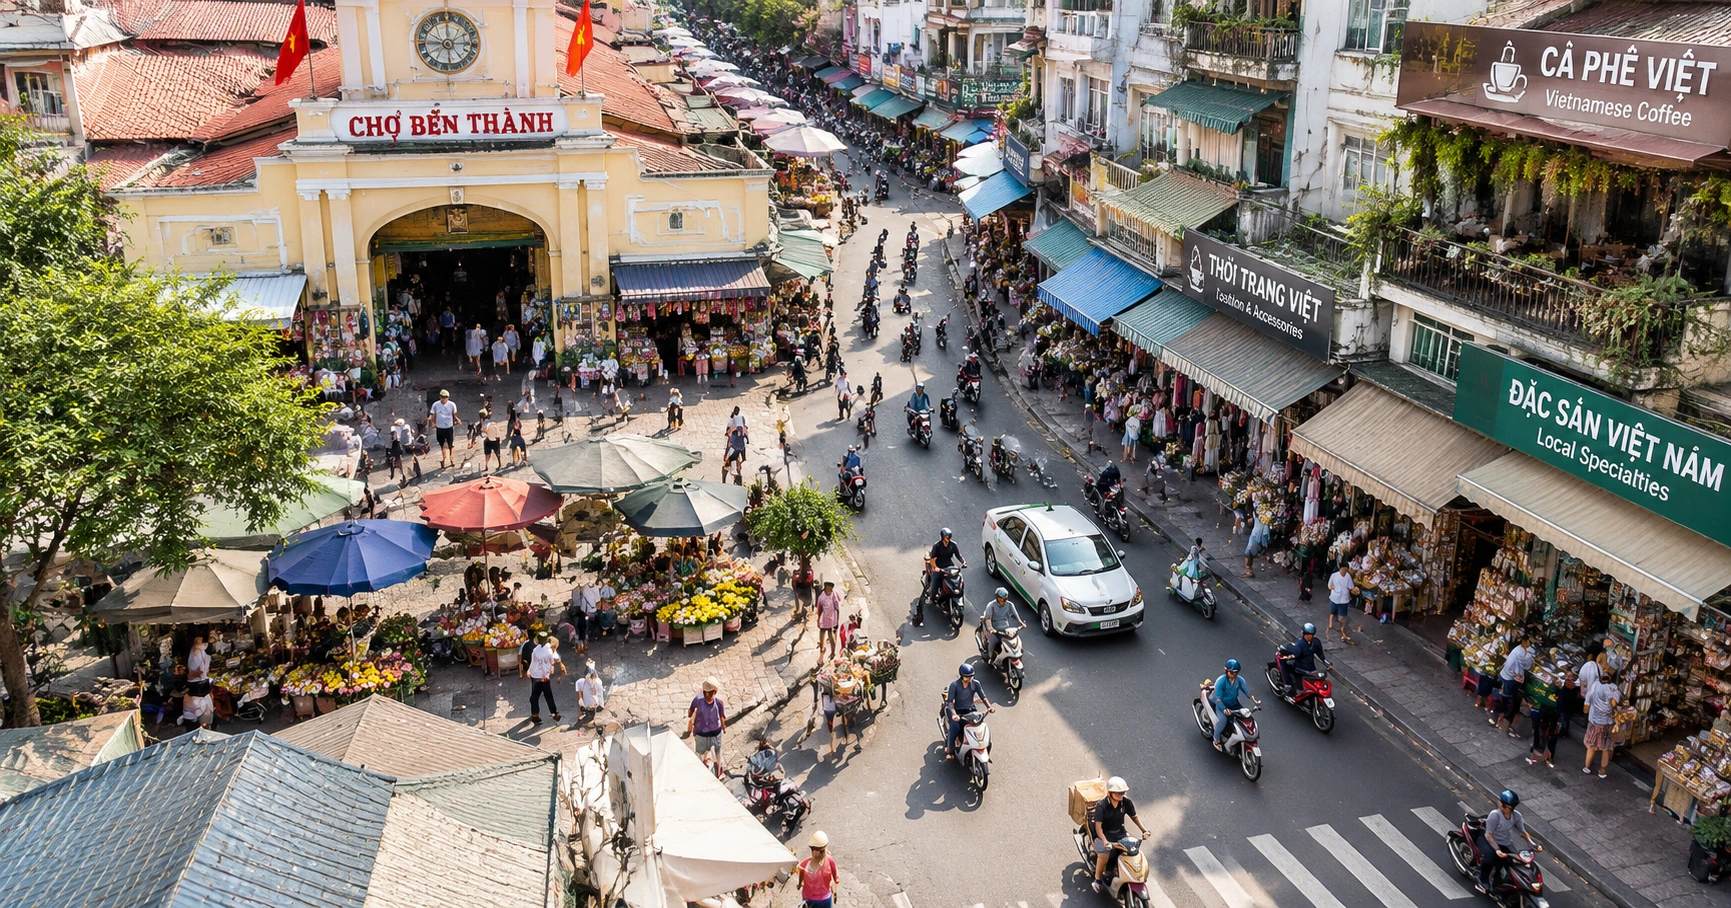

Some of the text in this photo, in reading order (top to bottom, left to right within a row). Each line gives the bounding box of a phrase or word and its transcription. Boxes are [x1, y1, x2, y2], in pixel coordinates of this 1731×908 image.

[1581, 44, 1639, 87] PHÊ
[1647, 48, 1718, 103] VIỆT
[1545, 88, 1692, 127] Vietnamese Coffee
[1241, 268, 1286, 307] TRANG
[1289, 288, 1322, 324] VIỆT
[1509, 378, 1552, 419] ĐẶC
[1608, 418, 1661, 463] VIỆT
[1537, 427, 1670, 501] Local Specialties
